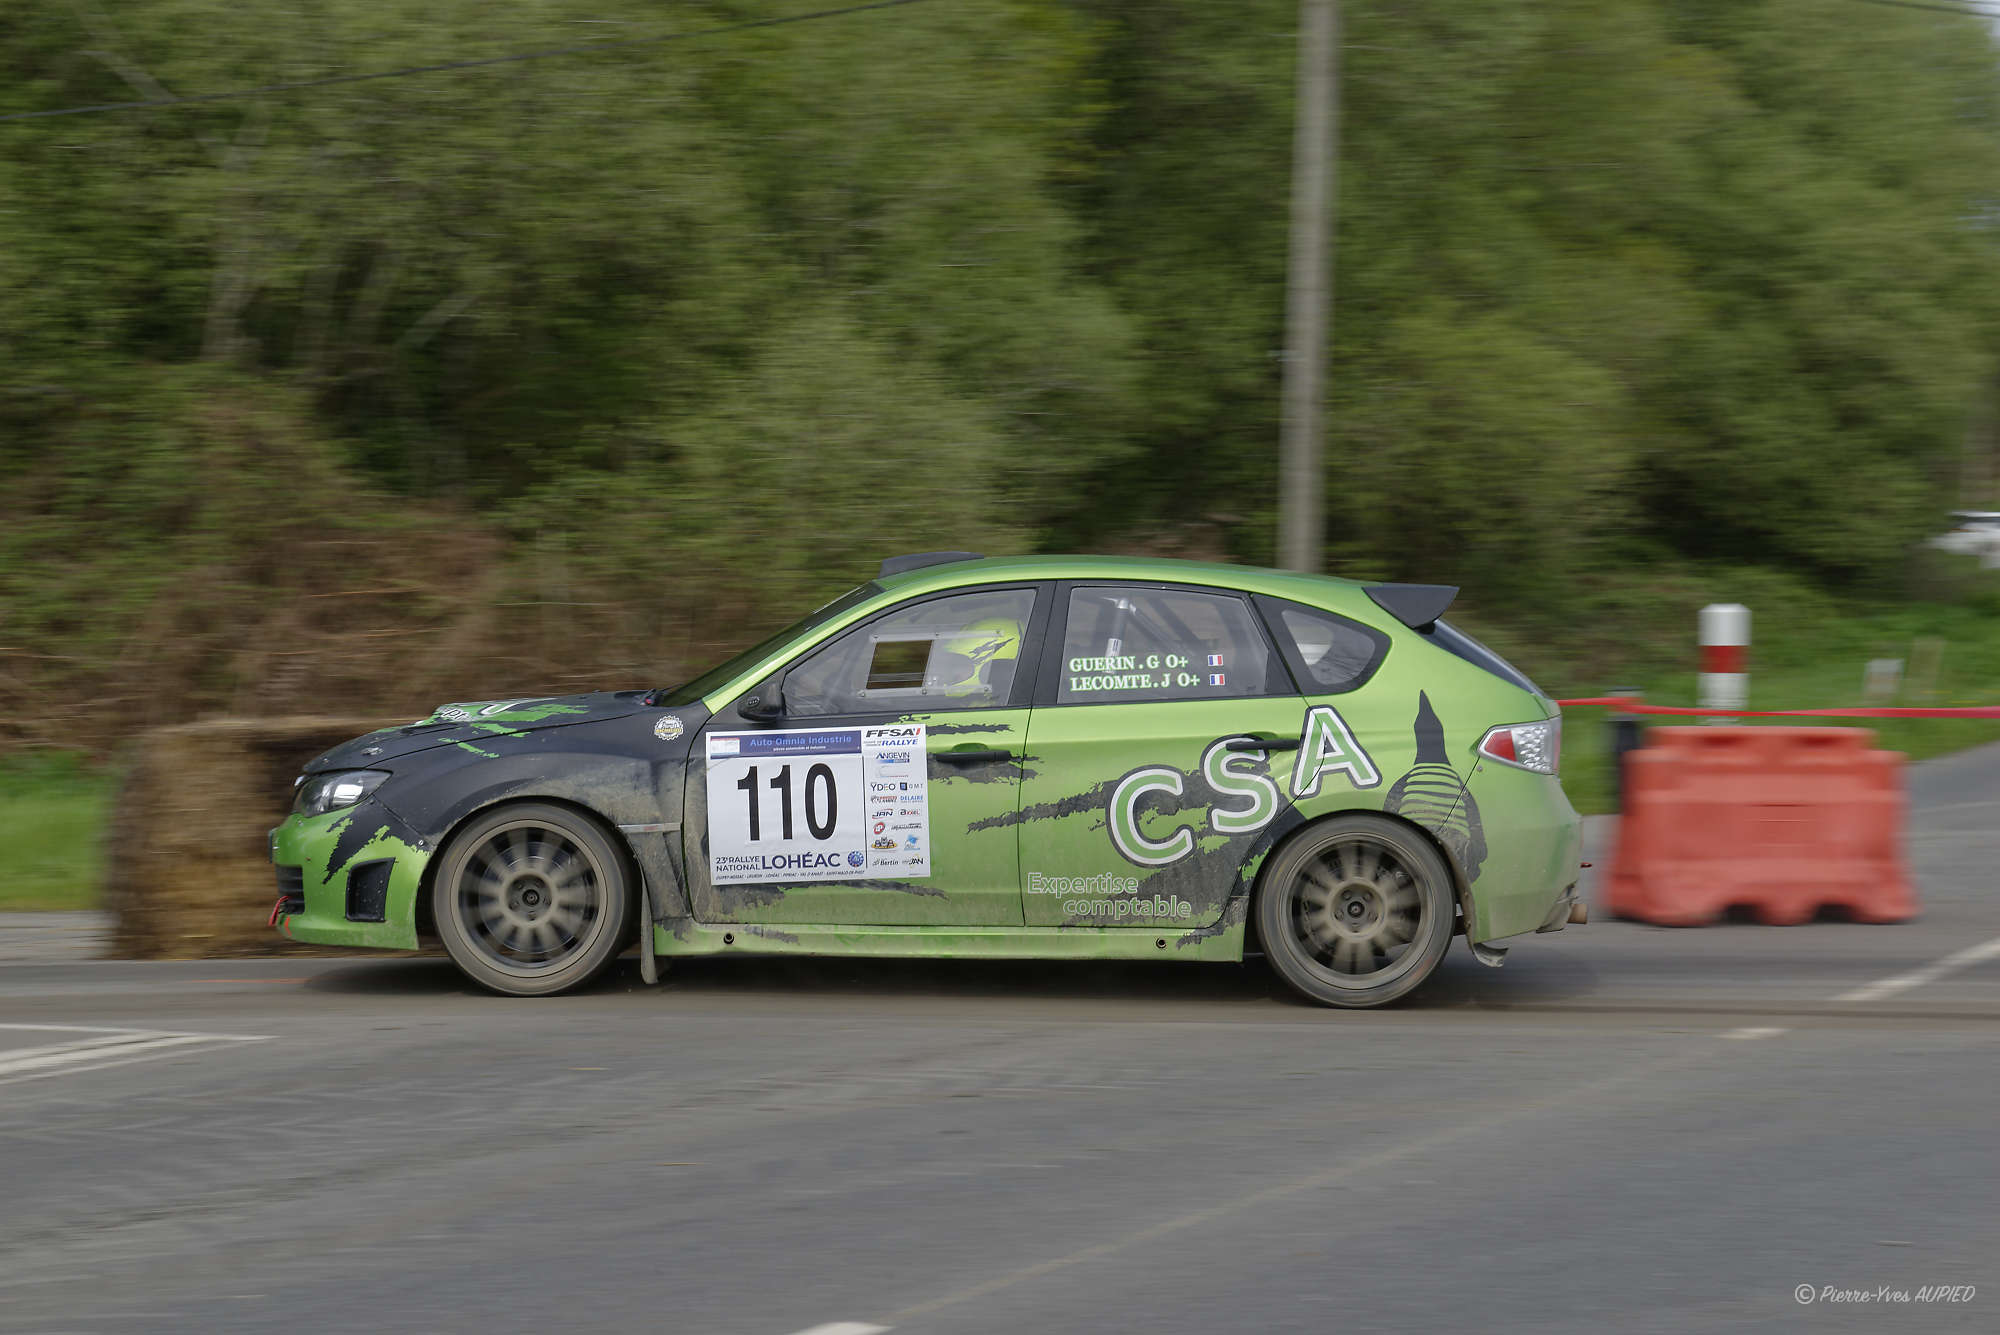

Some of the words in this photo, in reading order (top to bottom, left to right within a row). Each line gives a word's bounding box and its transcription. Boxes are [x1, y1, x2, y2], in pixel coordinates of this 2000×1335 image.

[1165, 654, 1188, 668] O+
[1176, 672, 1200, 687] O+
[866, 728, 914, 737] FFSA
[750, 737, 773, 747] Auto
[775, 735, 806, 746] Omnia
[808, 734, 853, 745] Industrie
[876, 751, 910, 759] ANGEVIN
[1106, 704, 1383, 868] CSA
[737, 762, 838, 841] 110
[728, 855, 760, 864] RALLYE
[761, 852, 841, 870] LOHÉAC
[716, 864, 760, 872] NATIONAL
[1027, 872, 1138, 898] Expertise
[1063, 895, 1192, 920] comptable
